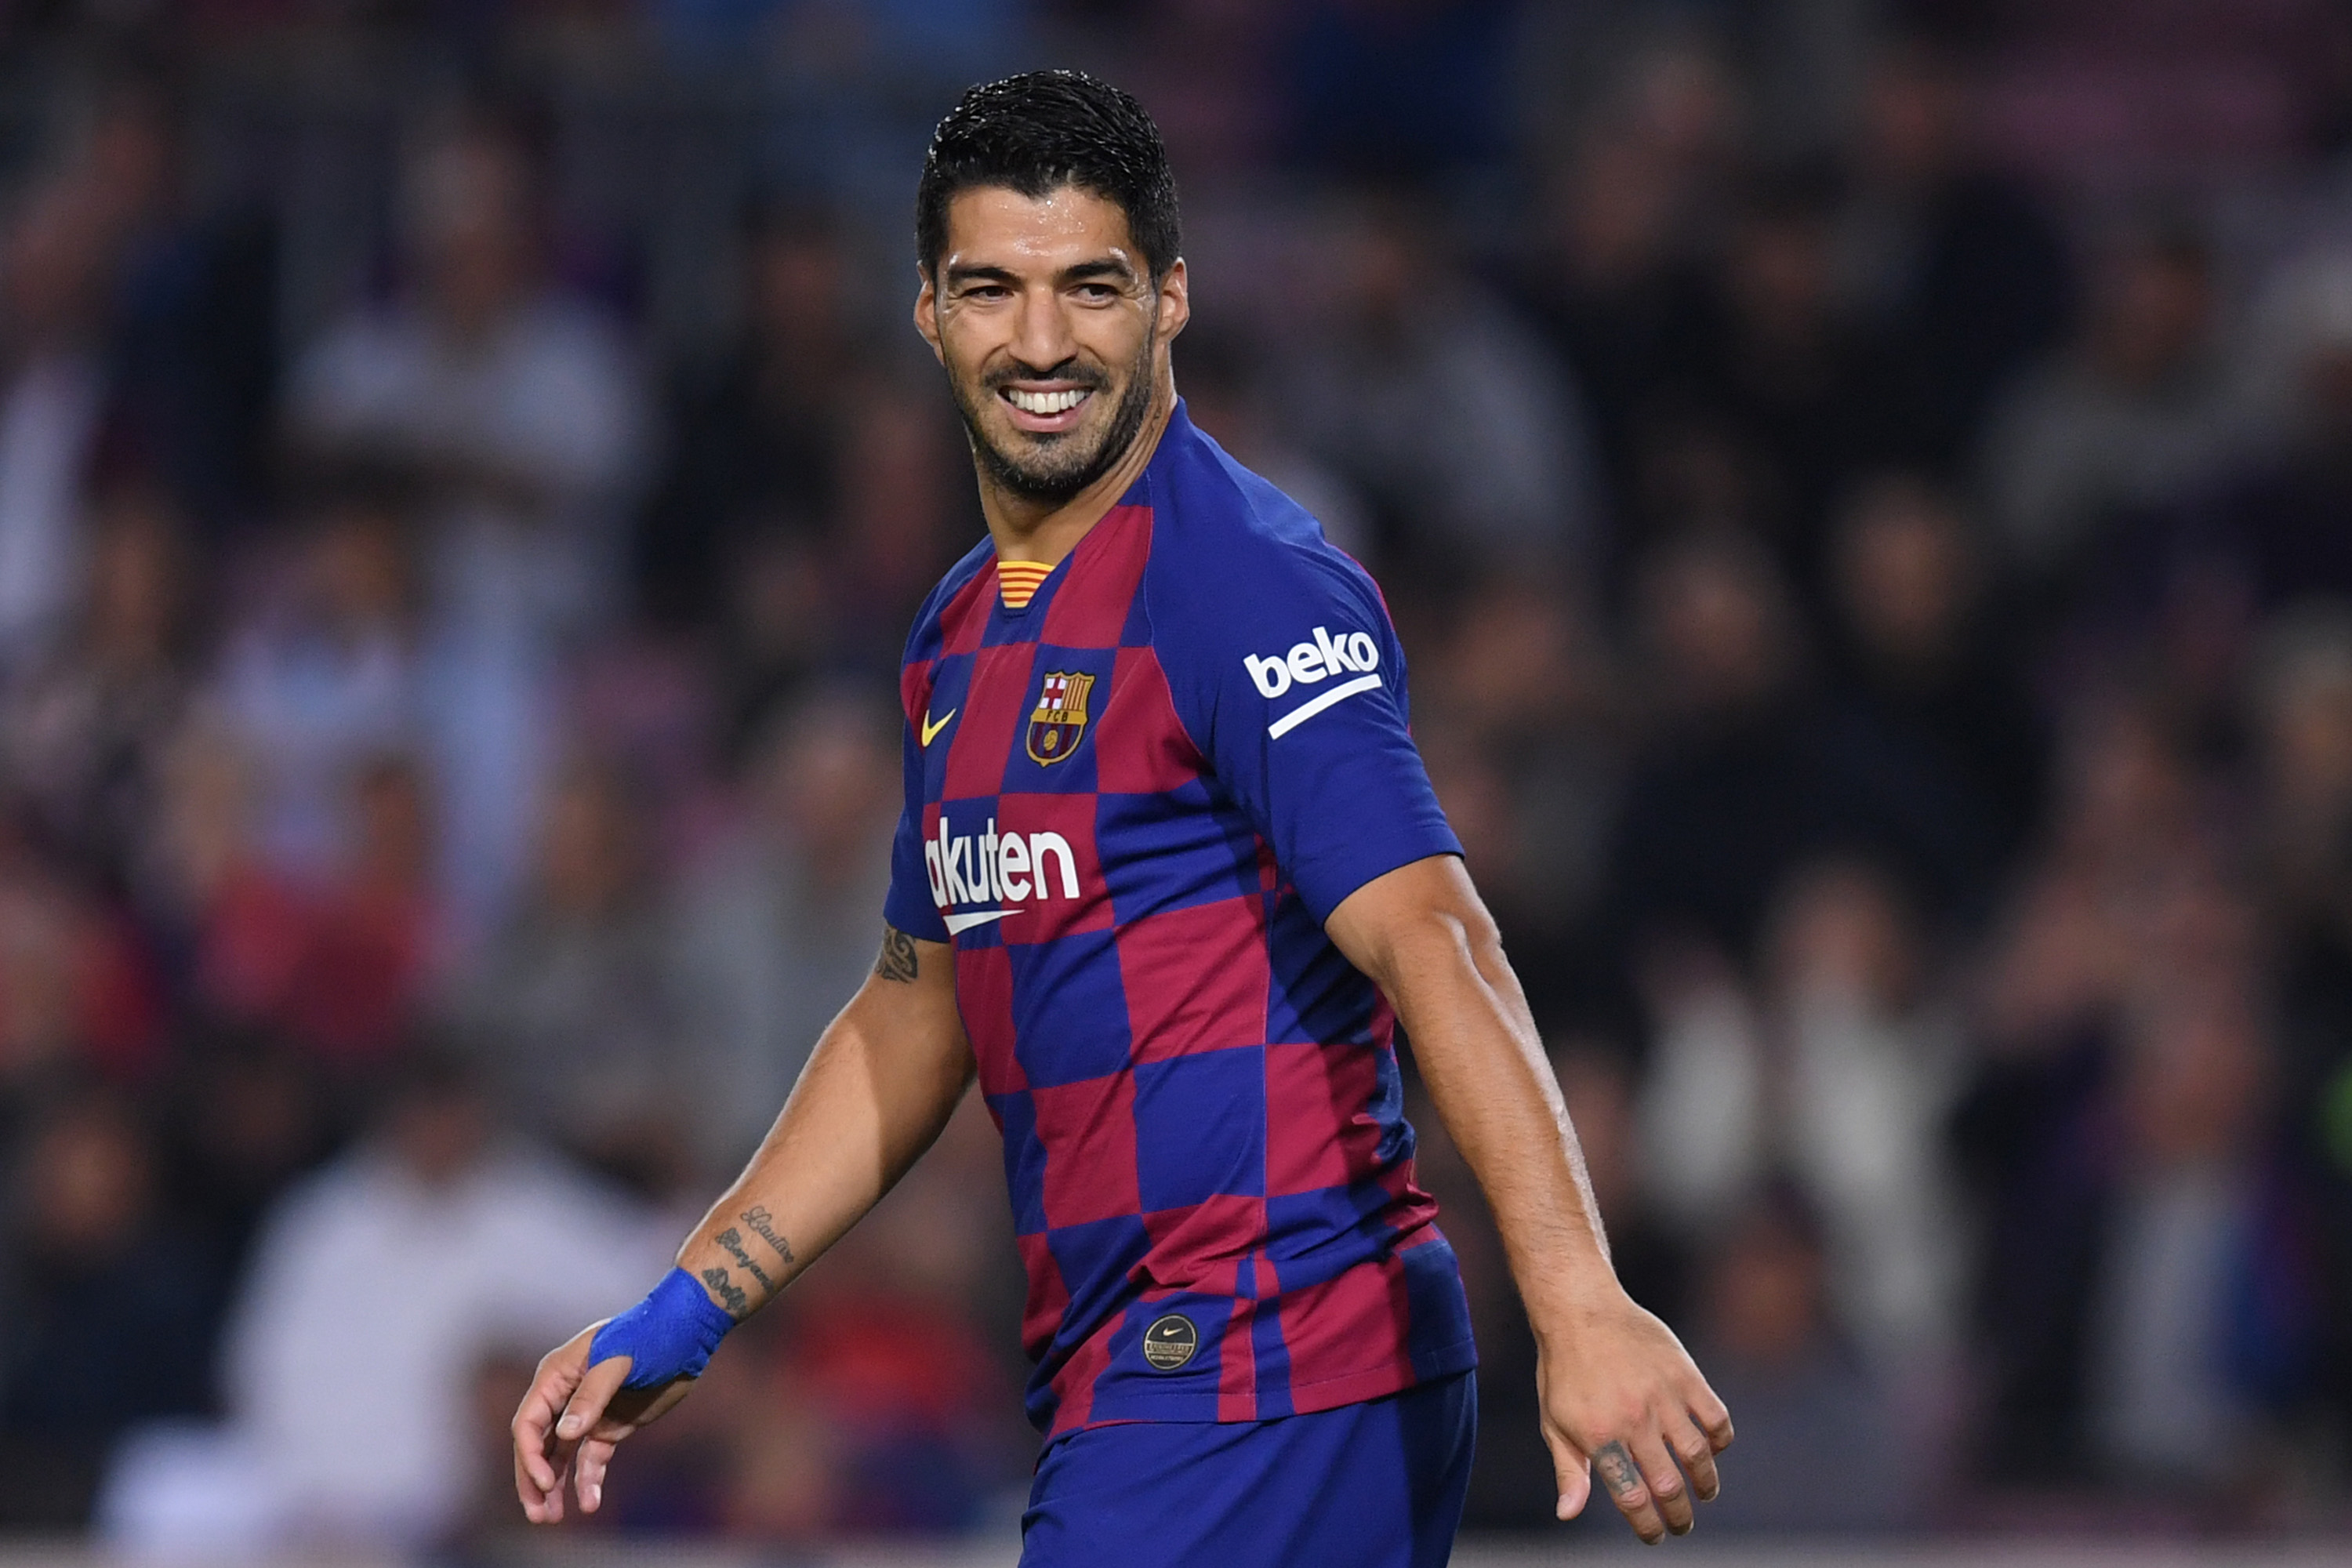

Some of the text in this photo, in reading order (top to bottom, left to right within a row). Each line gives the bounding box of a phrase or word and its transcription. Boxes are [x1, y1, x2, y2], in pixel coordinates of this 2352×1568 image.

[1243, 626, 1379, 699] beko
[1045, 710, 1069, 723] FCB
[925, 816, 1080, 909] akuten
